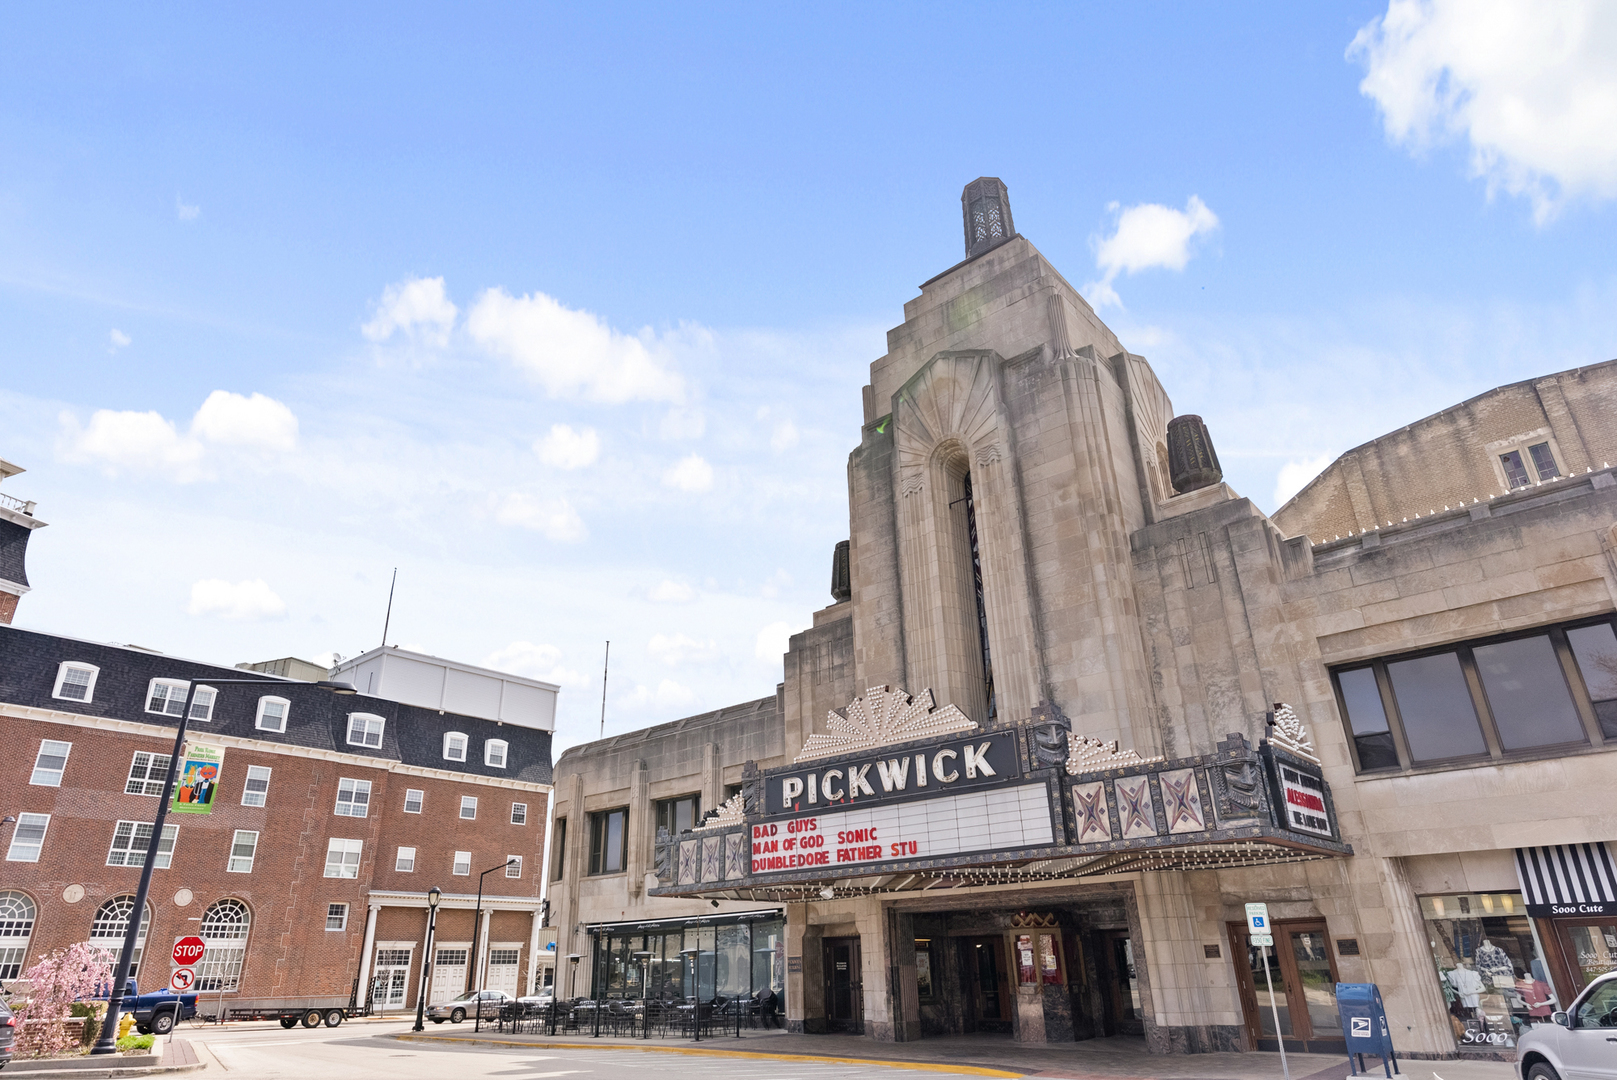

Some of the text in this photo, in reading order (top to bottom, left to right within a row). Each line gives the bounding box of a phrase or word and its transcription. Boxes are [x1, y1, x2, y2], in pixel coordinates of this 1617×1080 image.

[782, 741, 997, 809] PICKWICK
[753, 818, 817, 839] BAD GUYS
[752, 827, 877, 855] MAN OF GOD SONIC
[751, 840, 918, 872] DUMBLEDORE FATHER STU
[1552, 904, 1603, 914] Sooo Cute
[175, 945, 203, 957] STOP
[1580, 950, 1617, 959] Sooo Cut
[1462, 1028, 1508, 1043] Sooo
